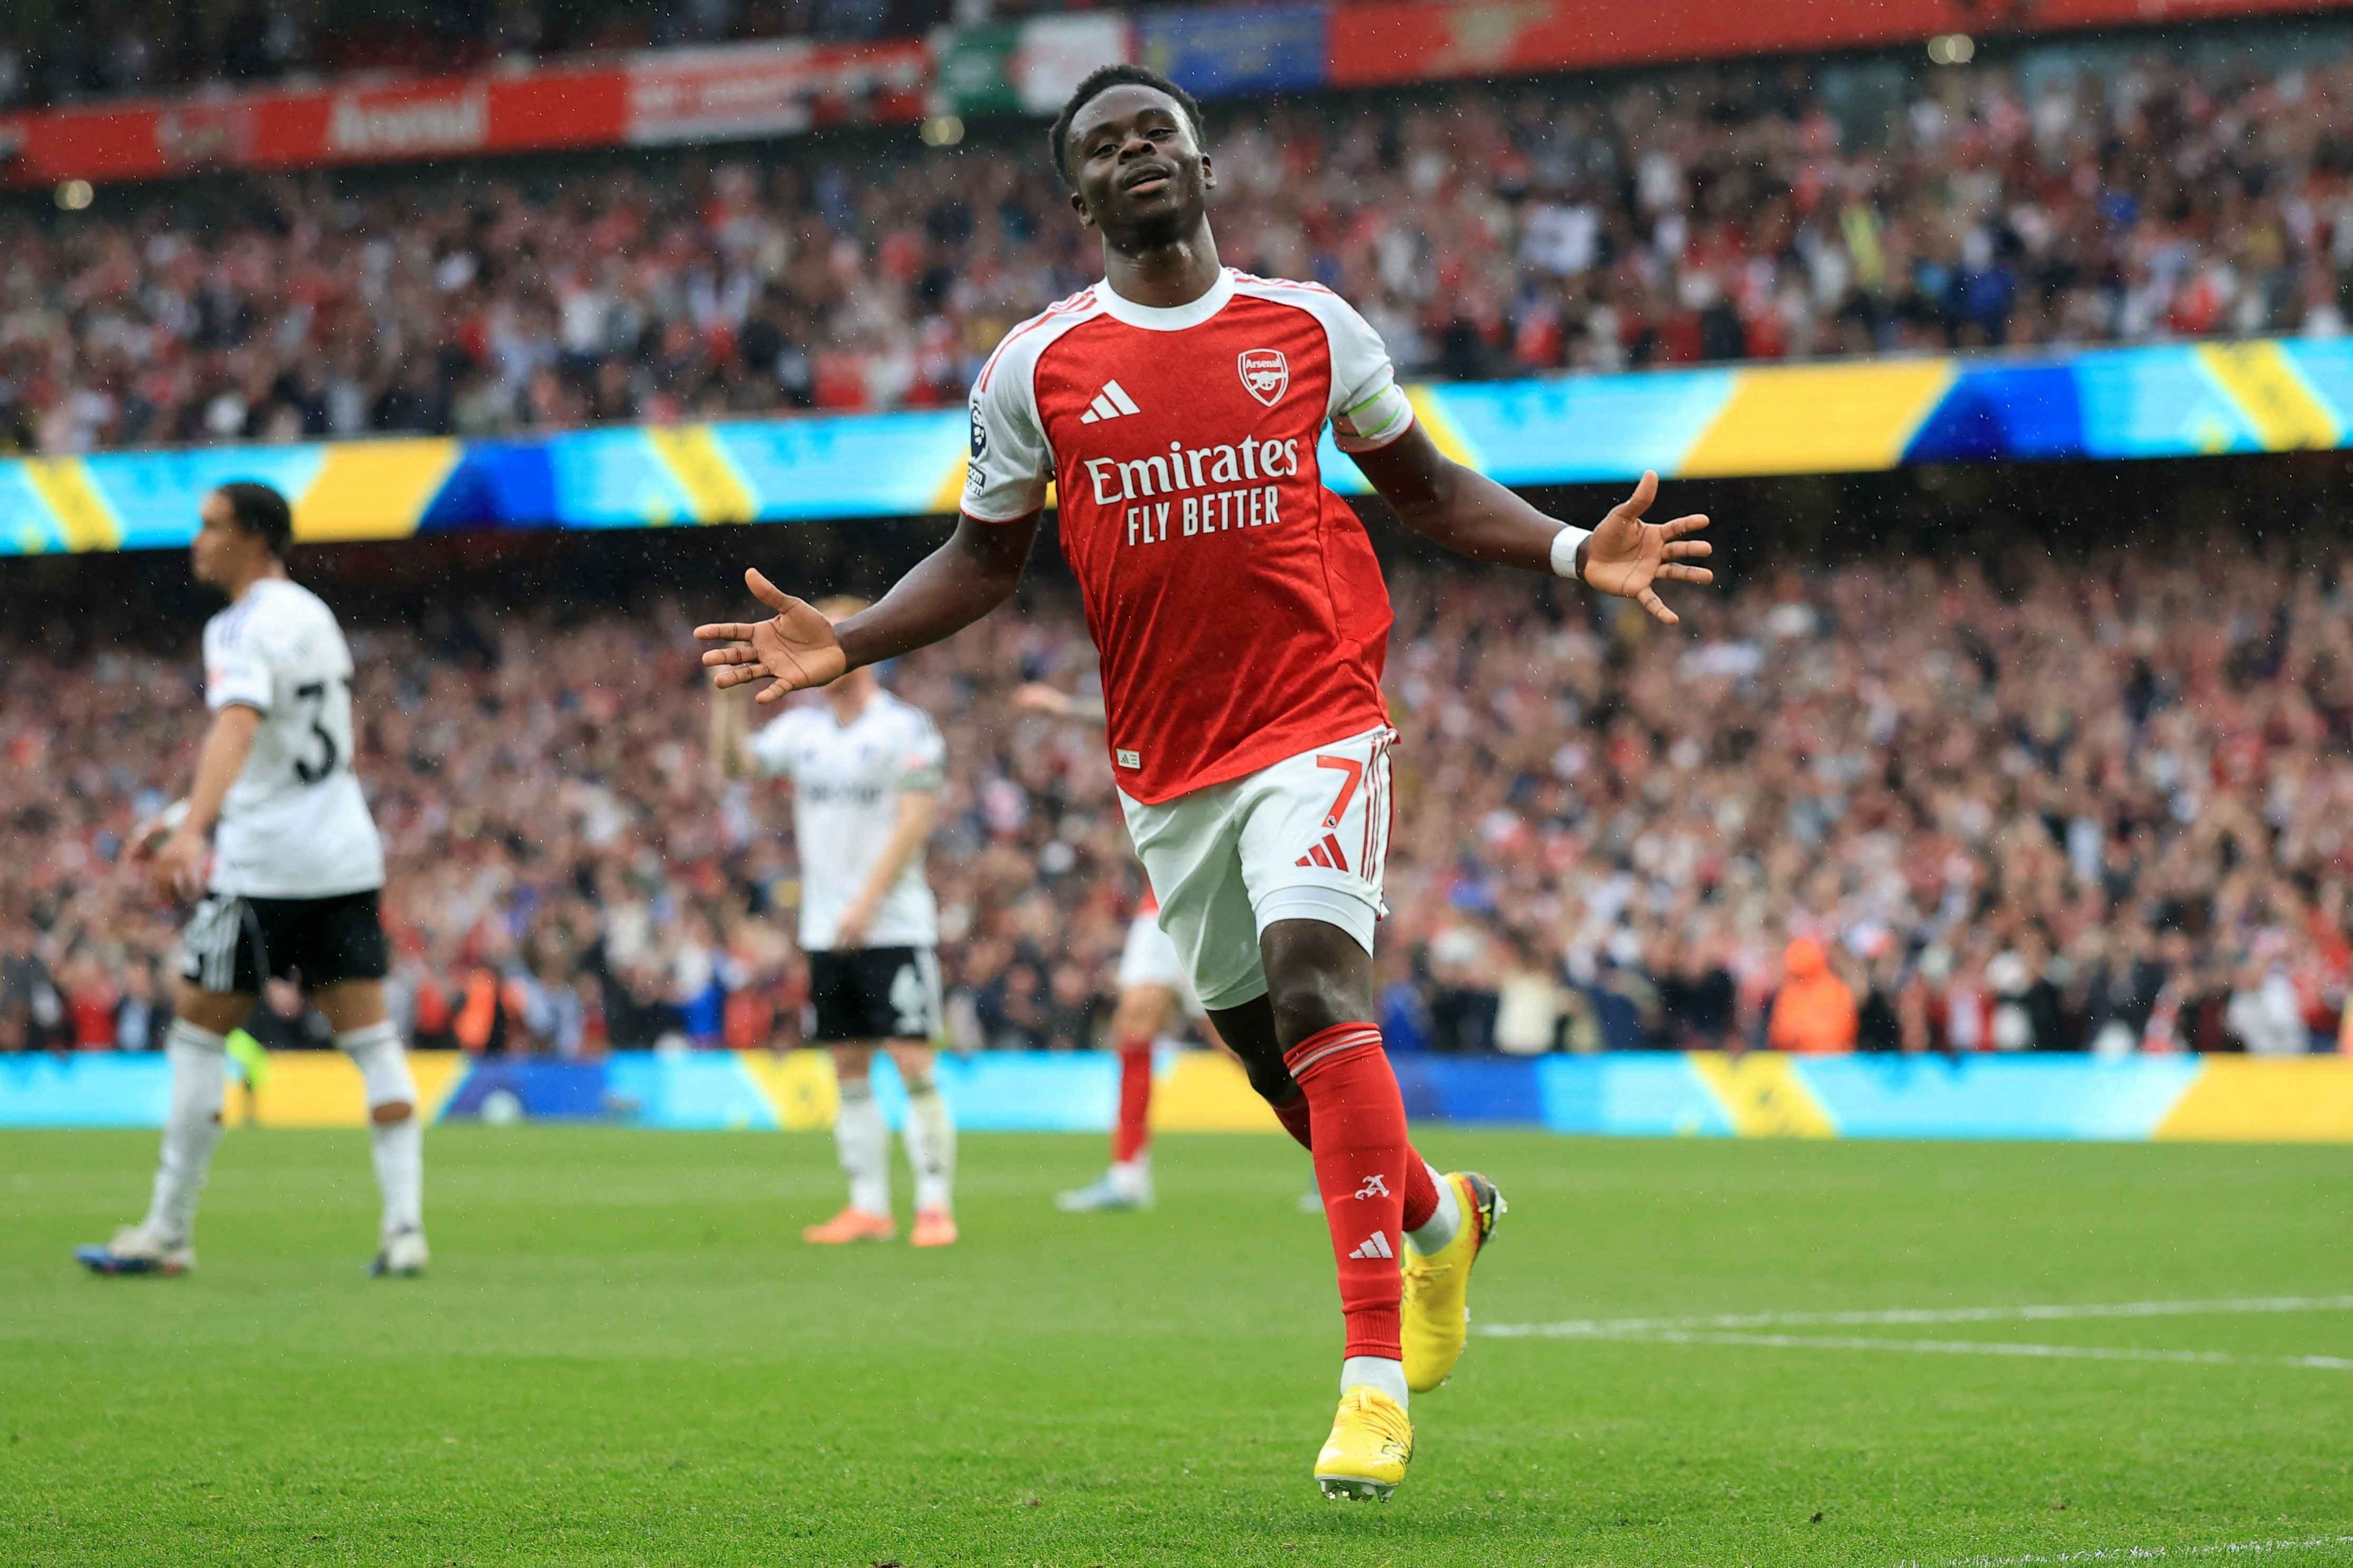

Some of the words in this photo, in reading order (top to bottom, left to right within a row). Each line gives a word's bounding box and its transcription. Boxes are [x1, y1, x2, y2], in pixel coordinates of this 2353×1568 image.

[1246, 359, 1281, 369] Arsenal
[1084, 434, 1298, 506] Emirates
[1127, 501, 1171, 546] FLY
[1182, 485, 1280, 537] BETTER
[293, 678, 353, 785] 3
[1317, 755, 1362, 829] 7
